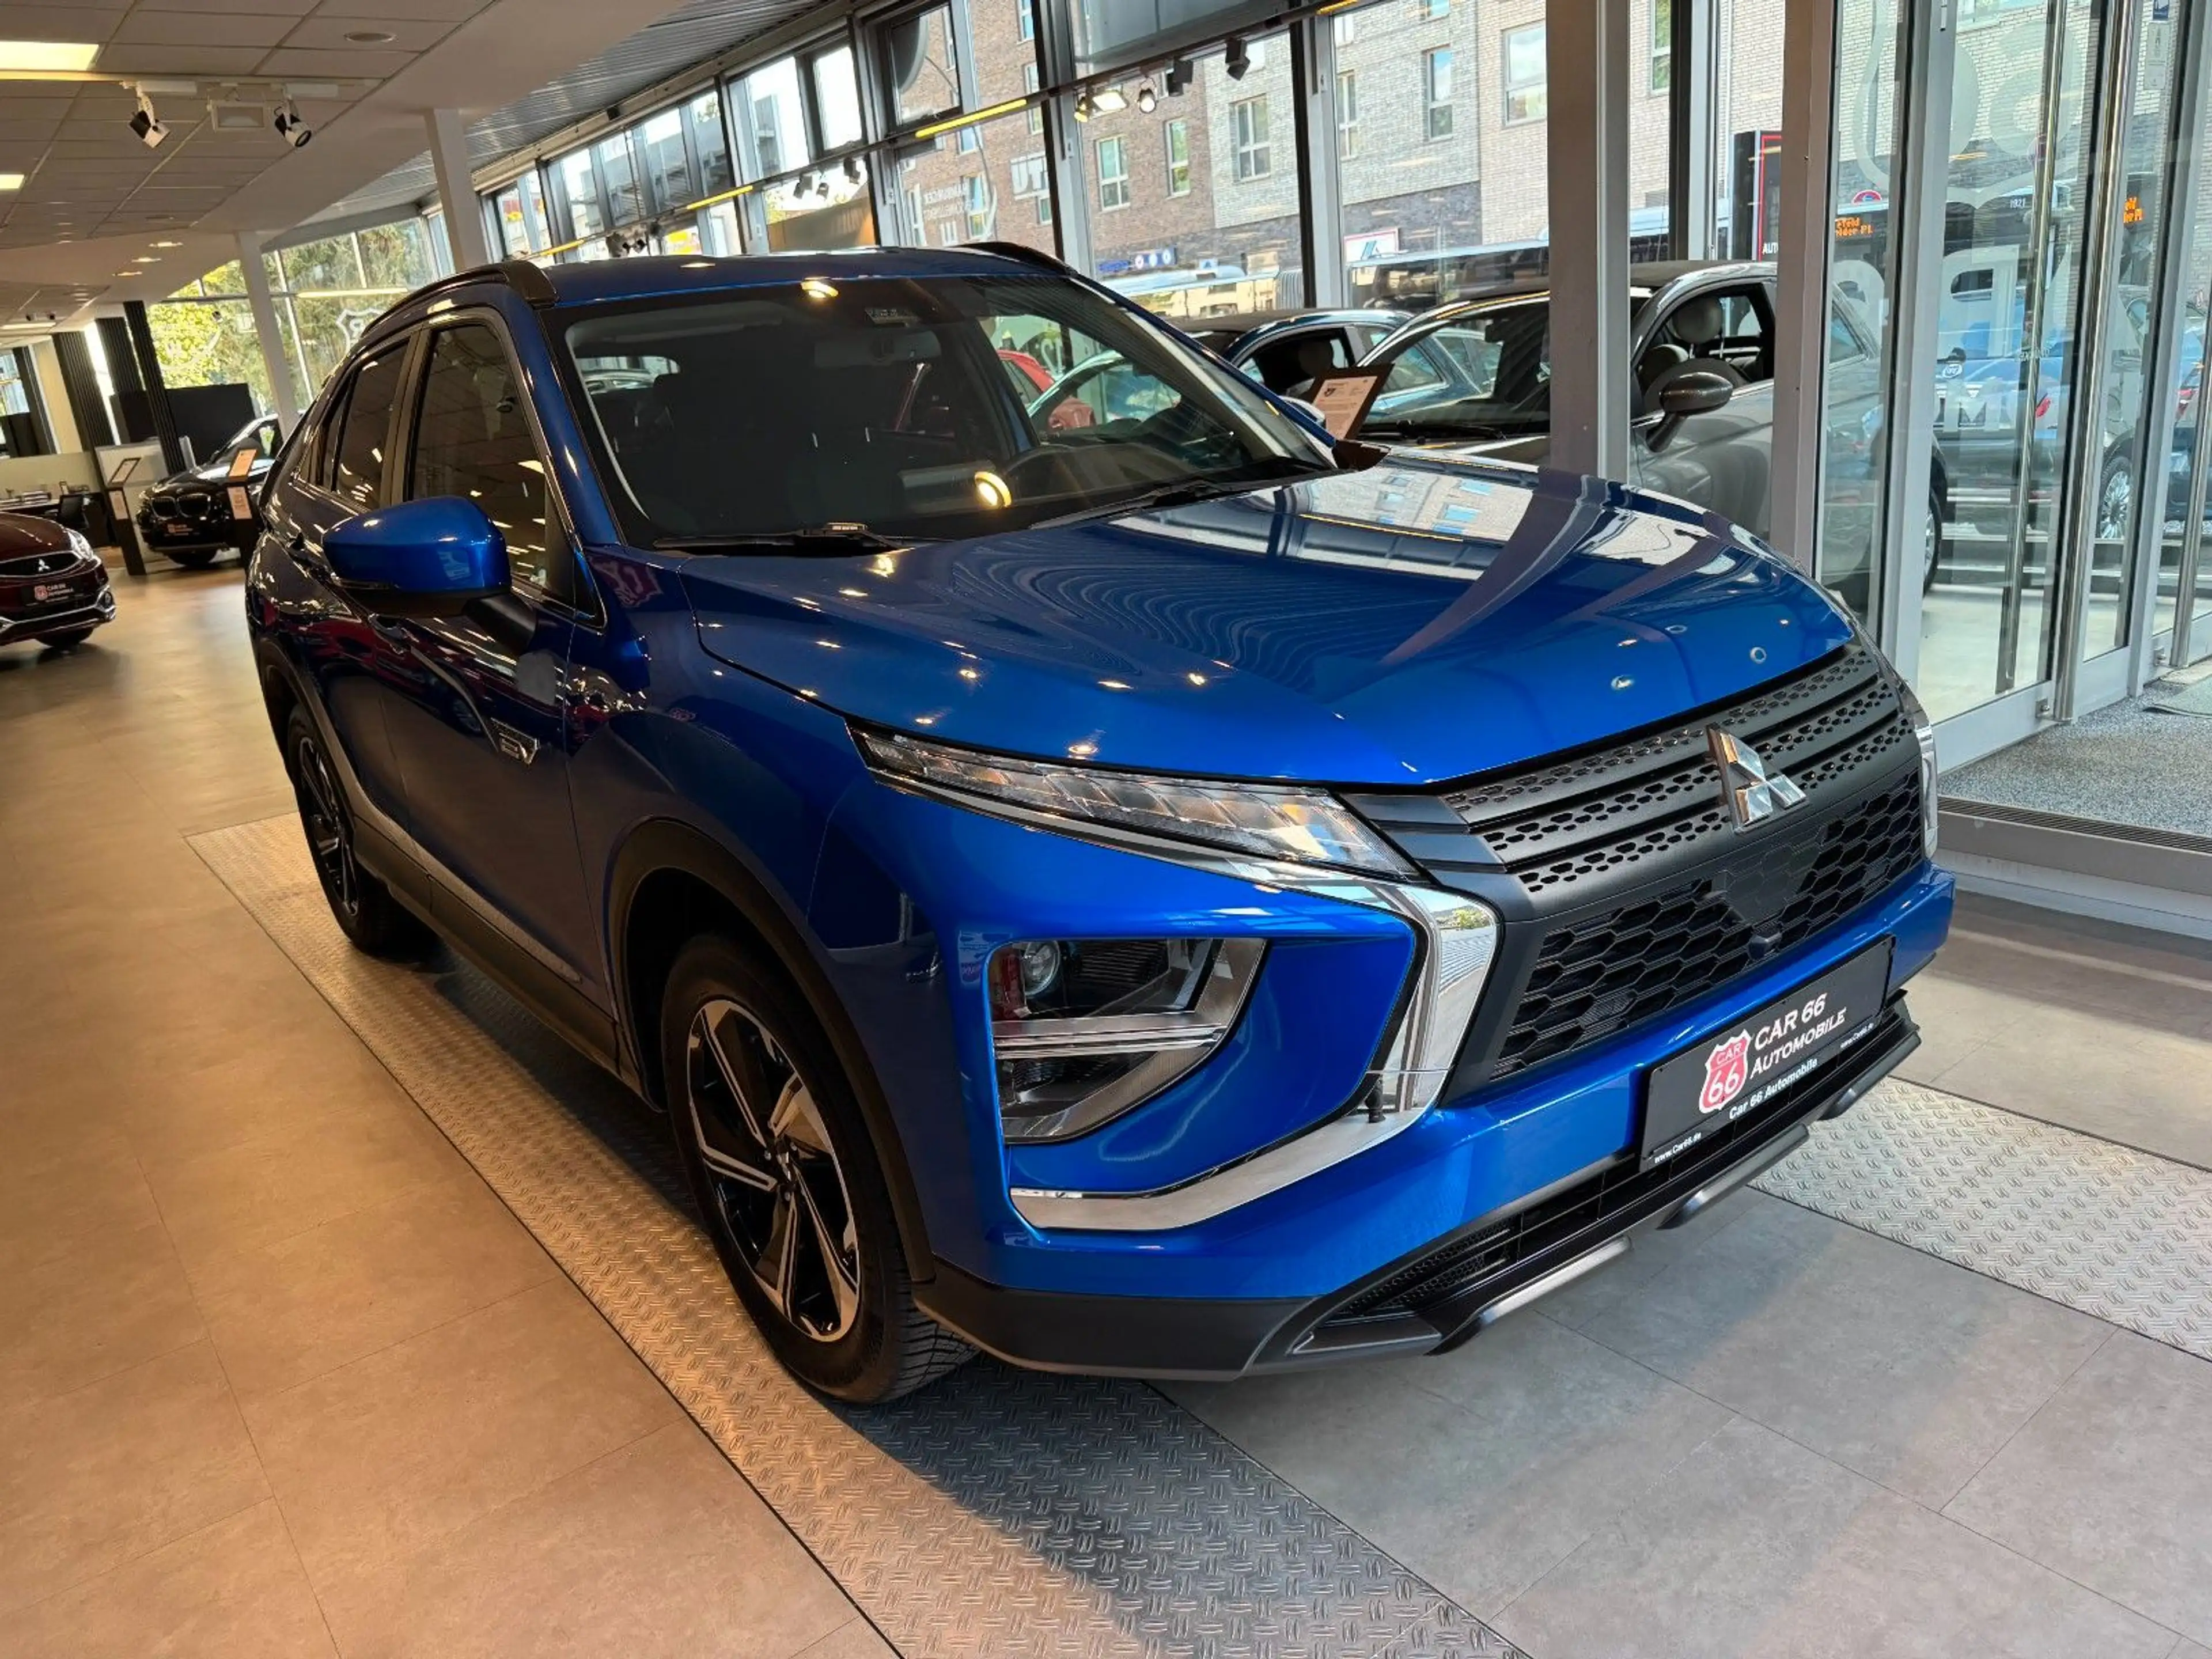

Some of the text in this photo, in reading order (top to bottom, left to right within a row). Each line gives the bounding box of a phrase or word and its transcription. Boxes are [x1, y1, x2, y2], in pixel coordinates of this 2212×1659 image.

[1749, 1006, 1847, 1080] AUTOMOBILE
[1755, 993, 1827, 1050] CAR 66
[1708, 1060, 1740, 1103] 66
[1717, 1042, 1742, 1064] CAR
[1729, 1058, 1818, 1119] Car 66 Automobile
